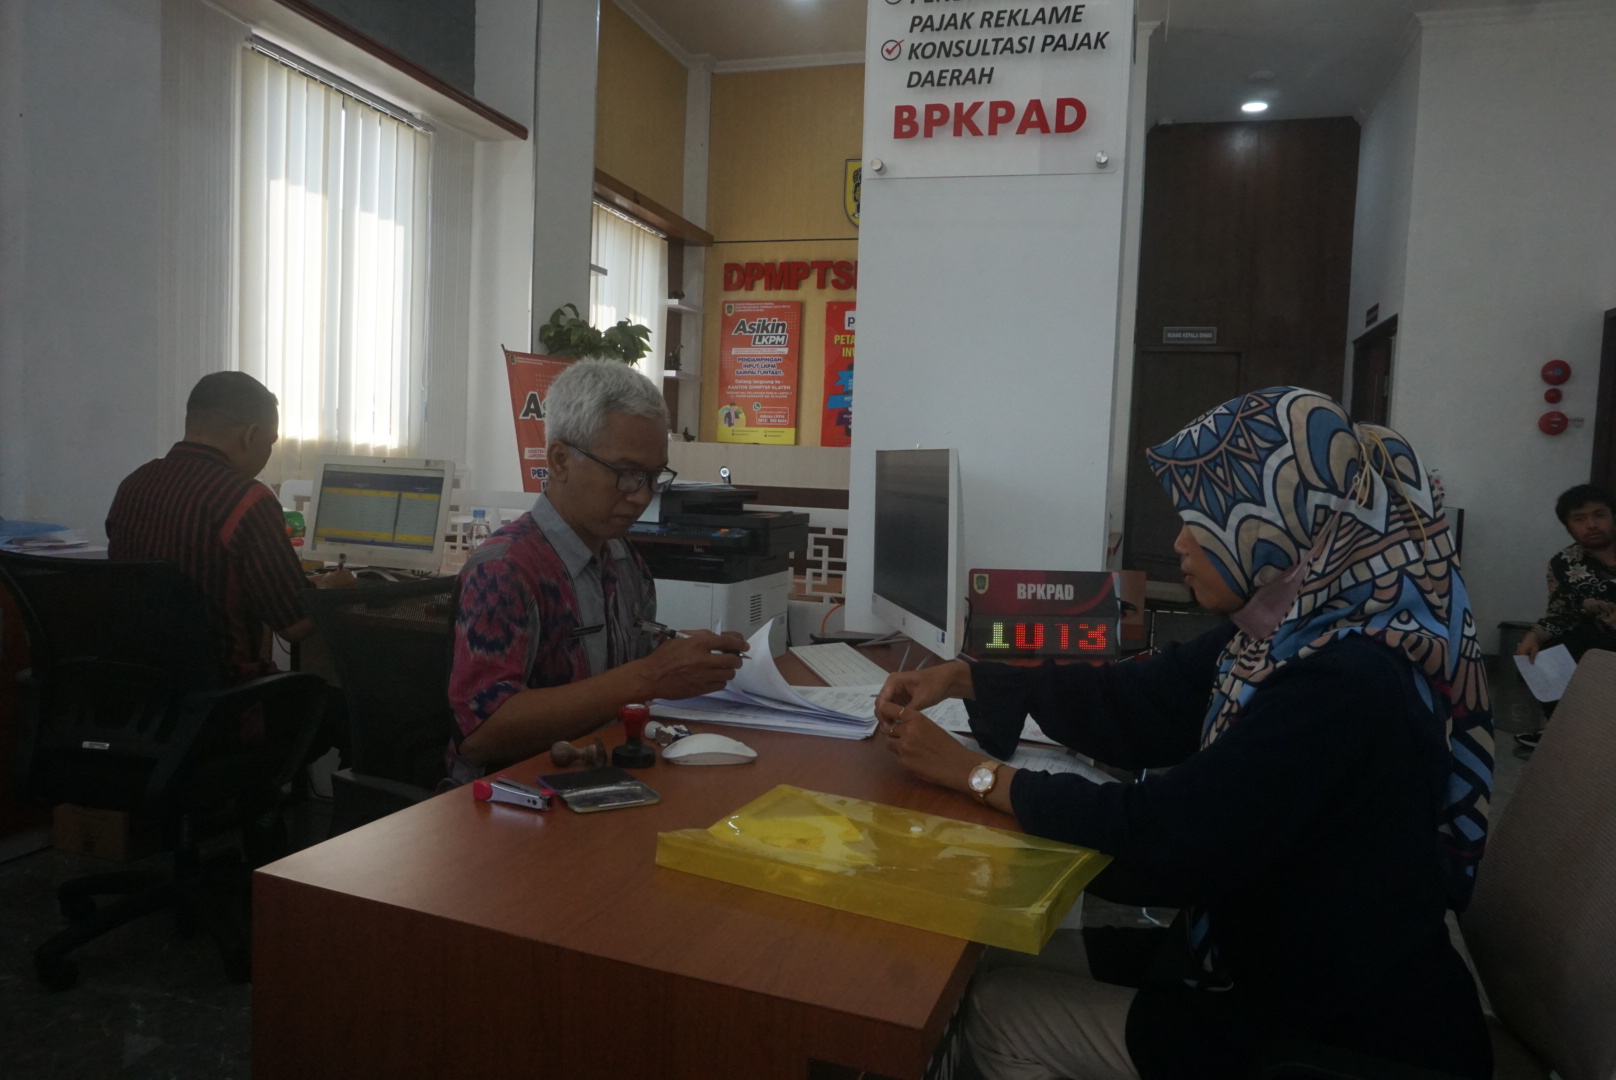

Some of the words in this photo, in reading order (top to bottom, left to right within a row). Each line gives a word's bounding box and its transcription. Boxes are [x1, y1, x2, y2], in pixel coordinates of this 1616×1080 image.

[909, 12, 975, 33] PAJAK
[979, 4, 1086, 28] REKLAME
[907, 36, 1036, 60] KONSULTASI
[1040, 31, 1110, 53] PAJAK
[906, 67, 994, 88] DAERAH
[893, 97, 1087, 139] BPKPAD
[723, 260, 858, 291] DPMPTS
[732, 318, 787, 335] Asikin
[754, 335, 786, 345] LKPM
[1016, 583, 1075, 600] BPKPAD
